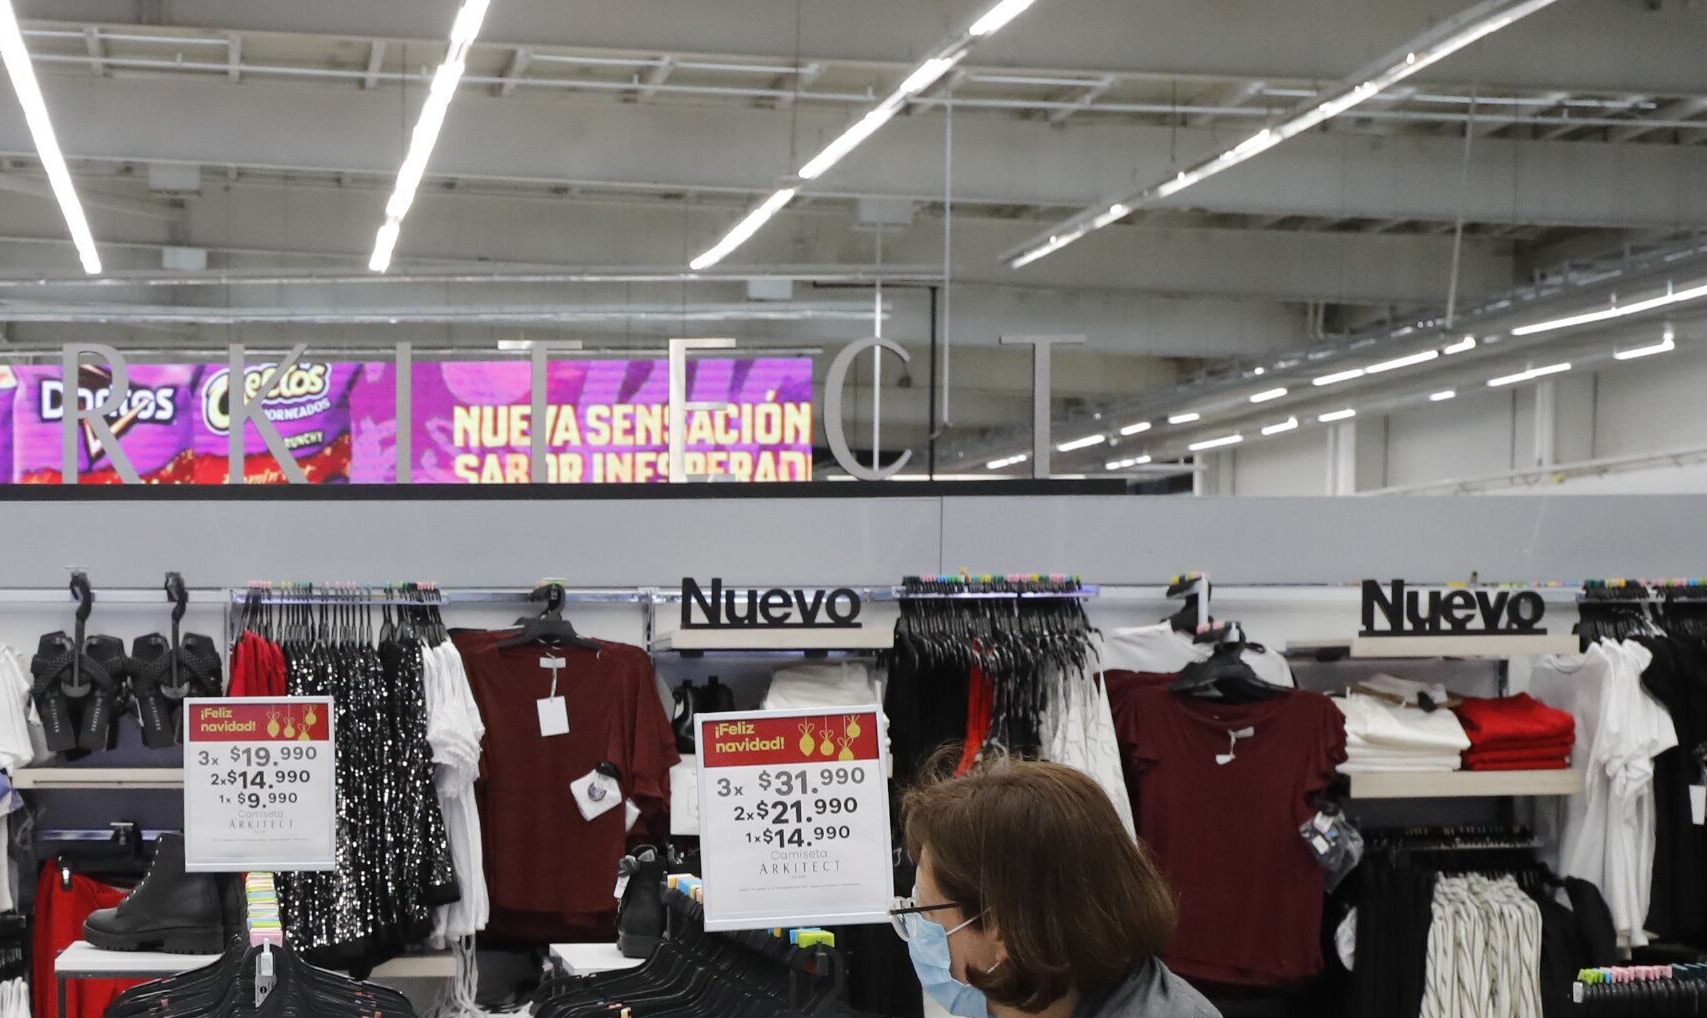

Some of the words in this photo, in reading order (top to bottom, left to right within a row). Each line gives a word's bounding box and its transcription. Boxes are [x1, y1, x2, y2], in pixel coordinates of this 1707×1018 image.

[41, 379, 174, 420] Dortos
[207, 364, 328, 429] Ceetos
[593, 451, 812, 484] INEPERAD
[681, 577, 861, 625] Nuevo
[1361, 579, 1546, 630] Nuevo
[201, 708, 232, 720] ¡Feliz
[201, 721, 256, 732] navidad!
[715, 721, 755, 738] ¡Feliz
[716, 737, 785, 753] navidad!
[230, 745, 317, 767] $19.990
[758, 767, 865, 796] $31.990
[237, 792, 298, 809] $9.990
[238, 809, 284, 818] Camiseta
[229, 819, 294, 829] ARKITECT
[771, 850, 828, 861] Camiseta
[759, 860, 841, 875] ARKITECT
